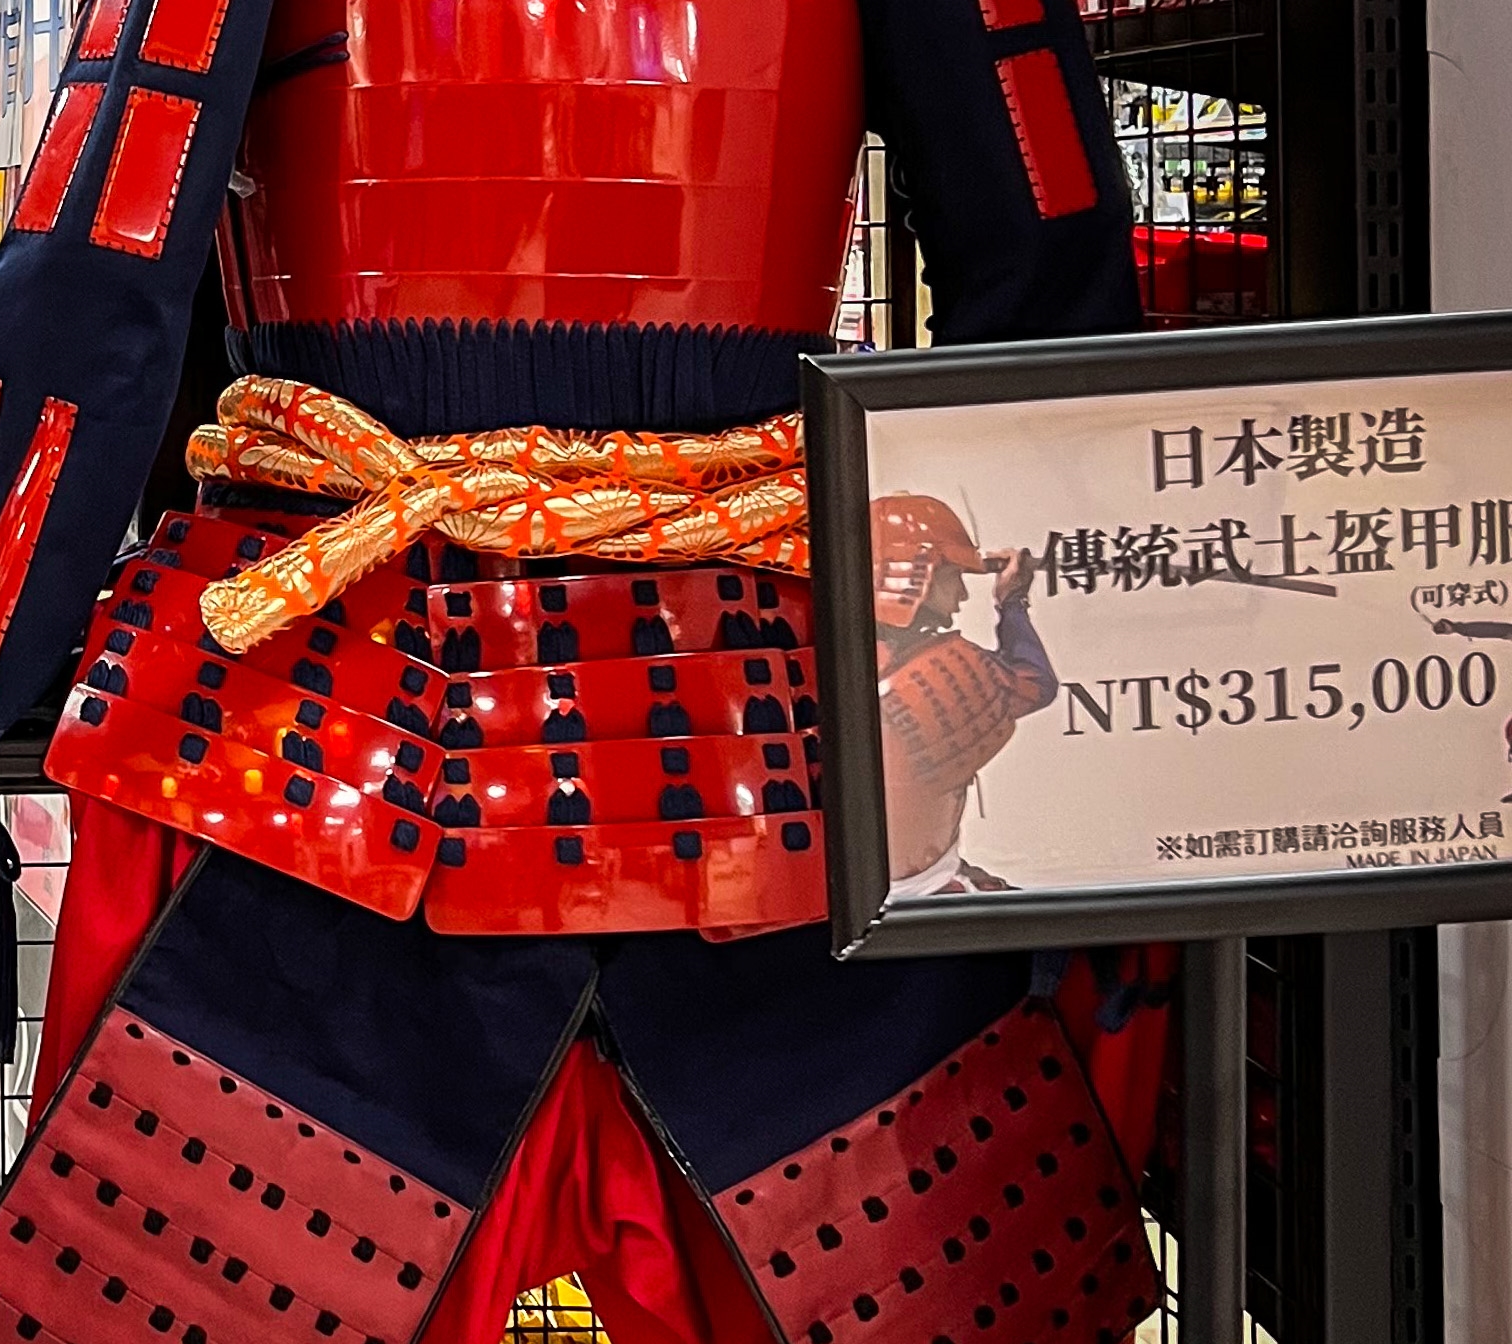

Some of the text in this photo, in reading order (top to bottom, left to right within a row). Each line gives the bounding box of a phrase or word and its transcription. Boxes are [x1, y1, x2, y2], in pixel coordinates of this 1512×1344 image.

[1151, 407, 1428, 492] 日本製造
[1042, 499, 1512, 598] 傳統武士盔甲服
[1060, 651, 1497, 736] NT$315,000
[1346, 844, 1498, 869] MADE IN JAPAN
